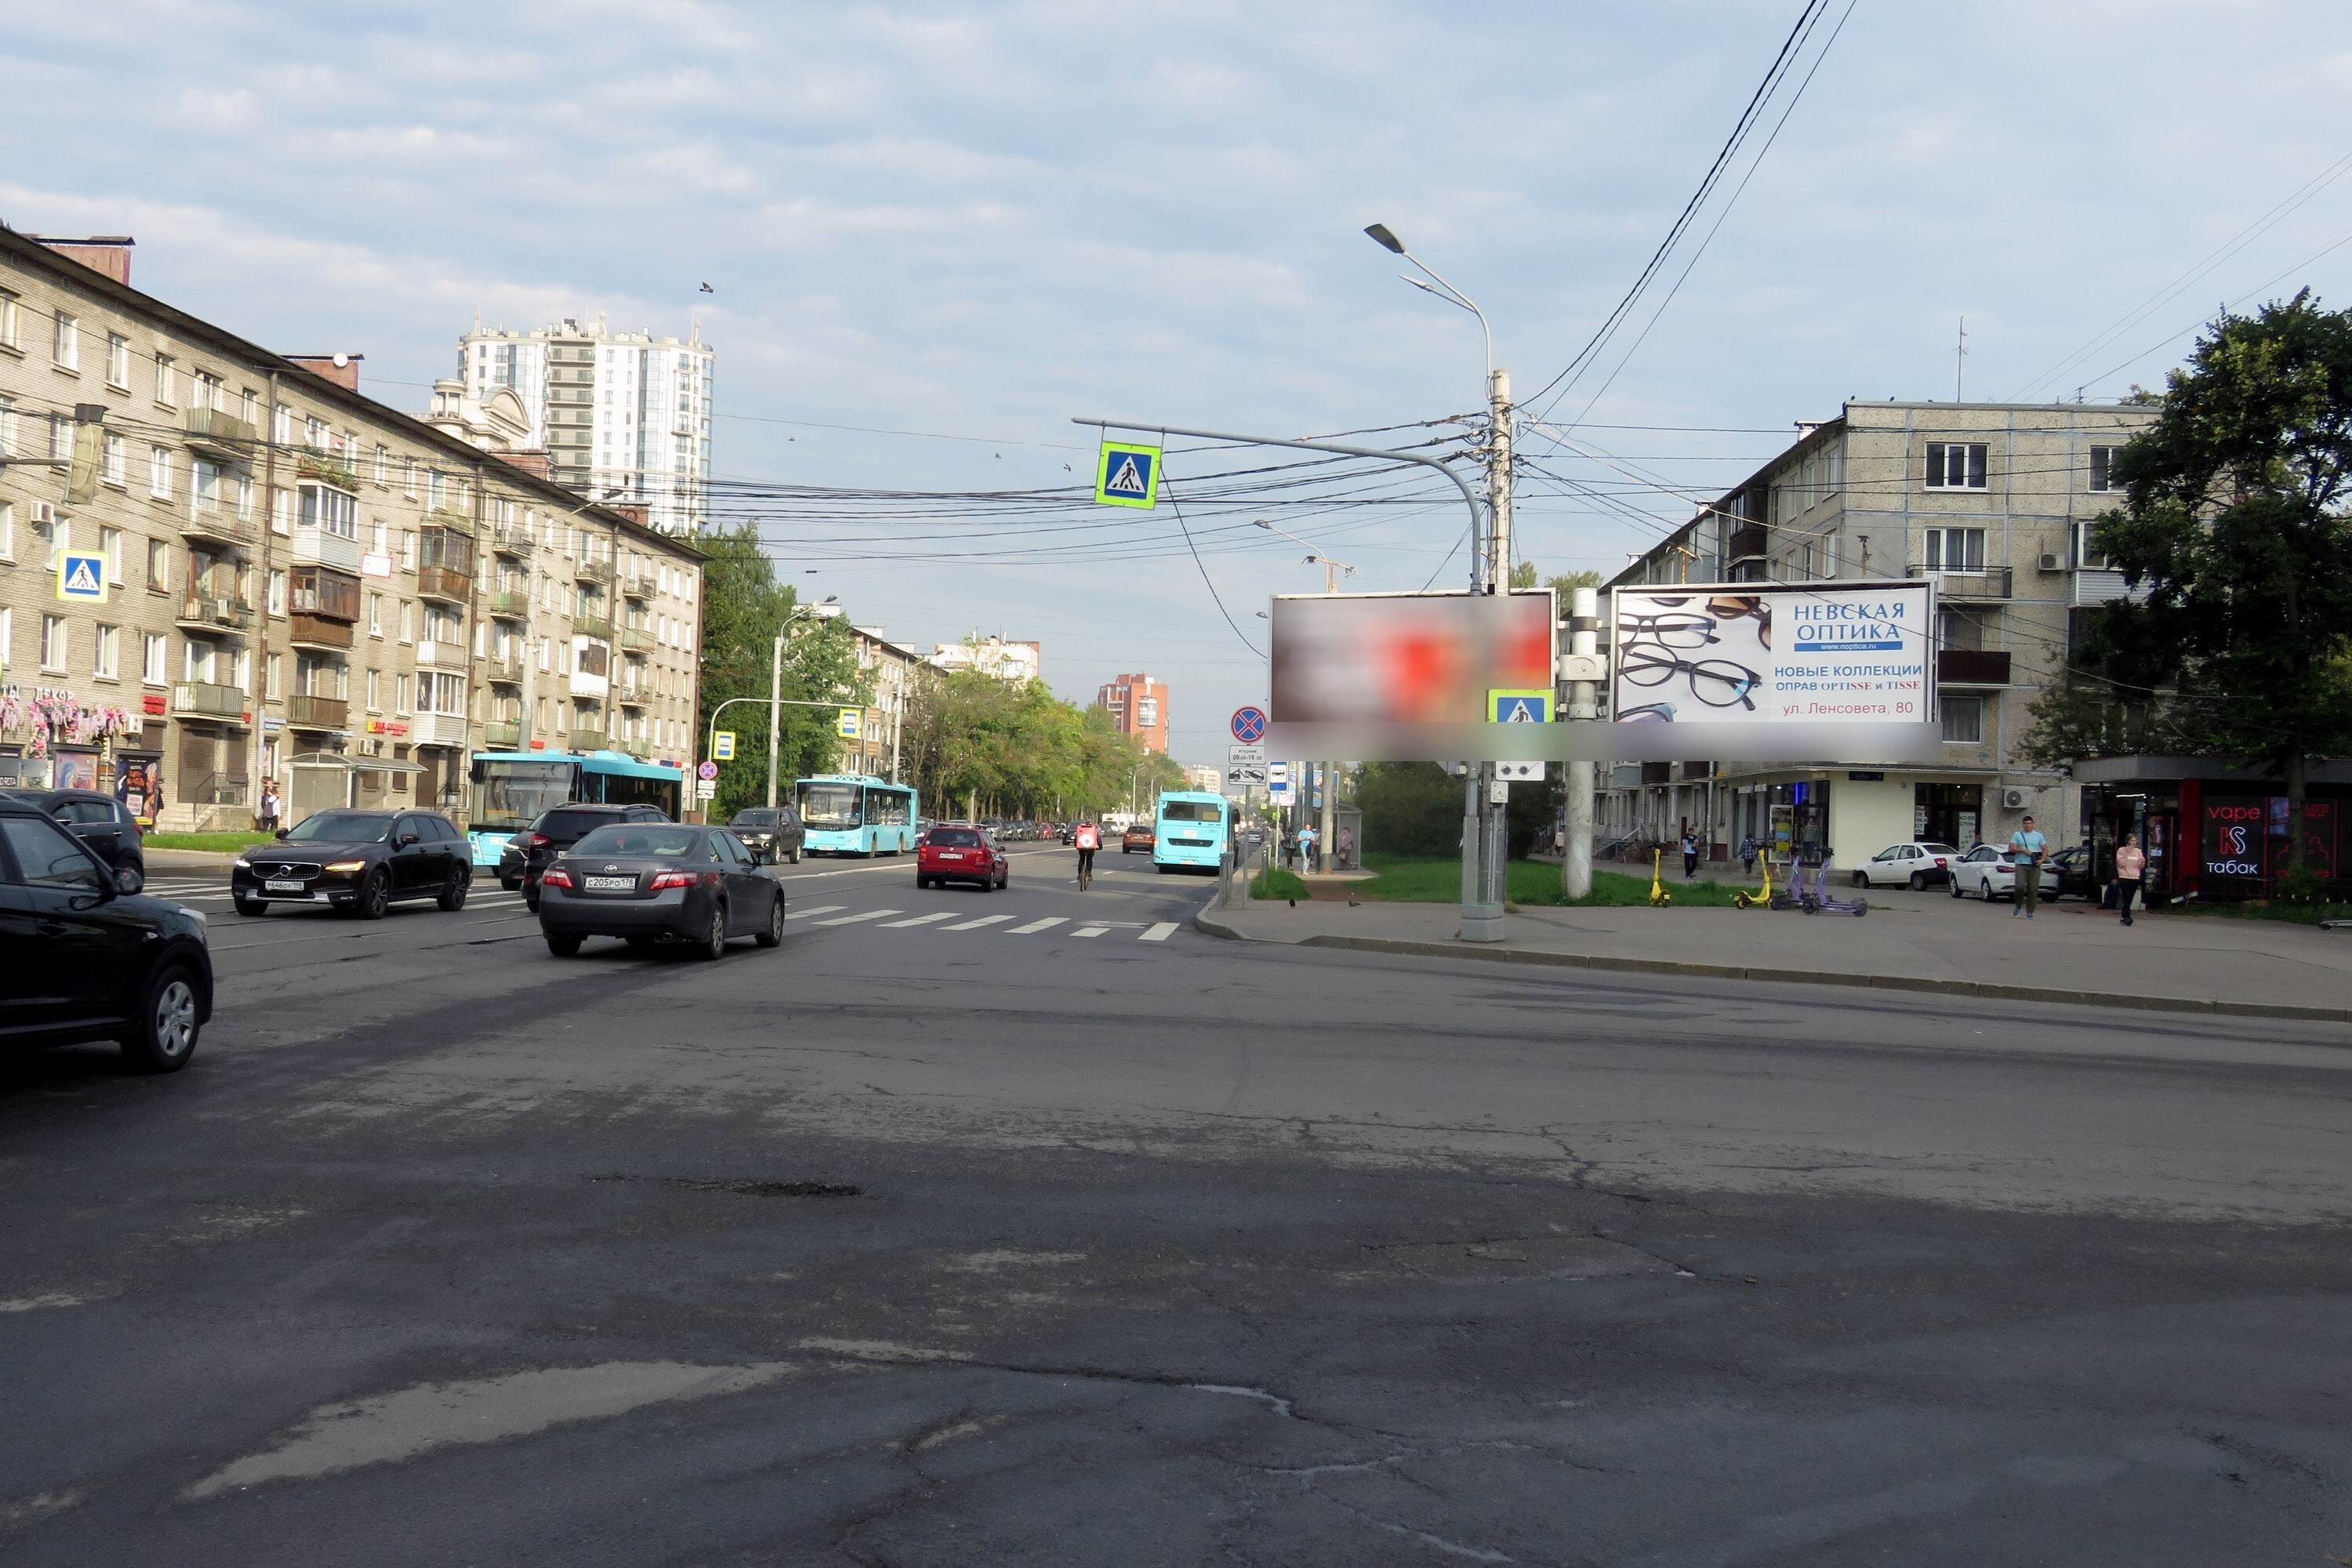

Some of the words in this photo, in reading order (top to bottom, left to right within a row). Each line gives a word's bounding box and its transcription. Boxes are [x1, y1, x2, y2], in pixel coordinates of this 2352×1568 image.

[1794, 603, 1904, 620] НЕВСКАЯ
[1797, 623, 1900, 641] ОПТИКА
[1774, 666, 1828, 677] НОВЫЕ
[1834, 665, 1922, 677] КОЛЛЕКЦИИ
[1776, 682, 1817, 691] ОПРАВ
[1821, 681, 1872, 691] OPTISSE
[1886, 681, 1921, 690] TISSE
[1783, 705, 1803, 717] ул.
[1809, 702, 1890, 715] Ленсовета,
[1896, 702, 1914, 713] 80
[2208, 807, 2260, 822] vape
[2206, 859, 2259, 875] табак
